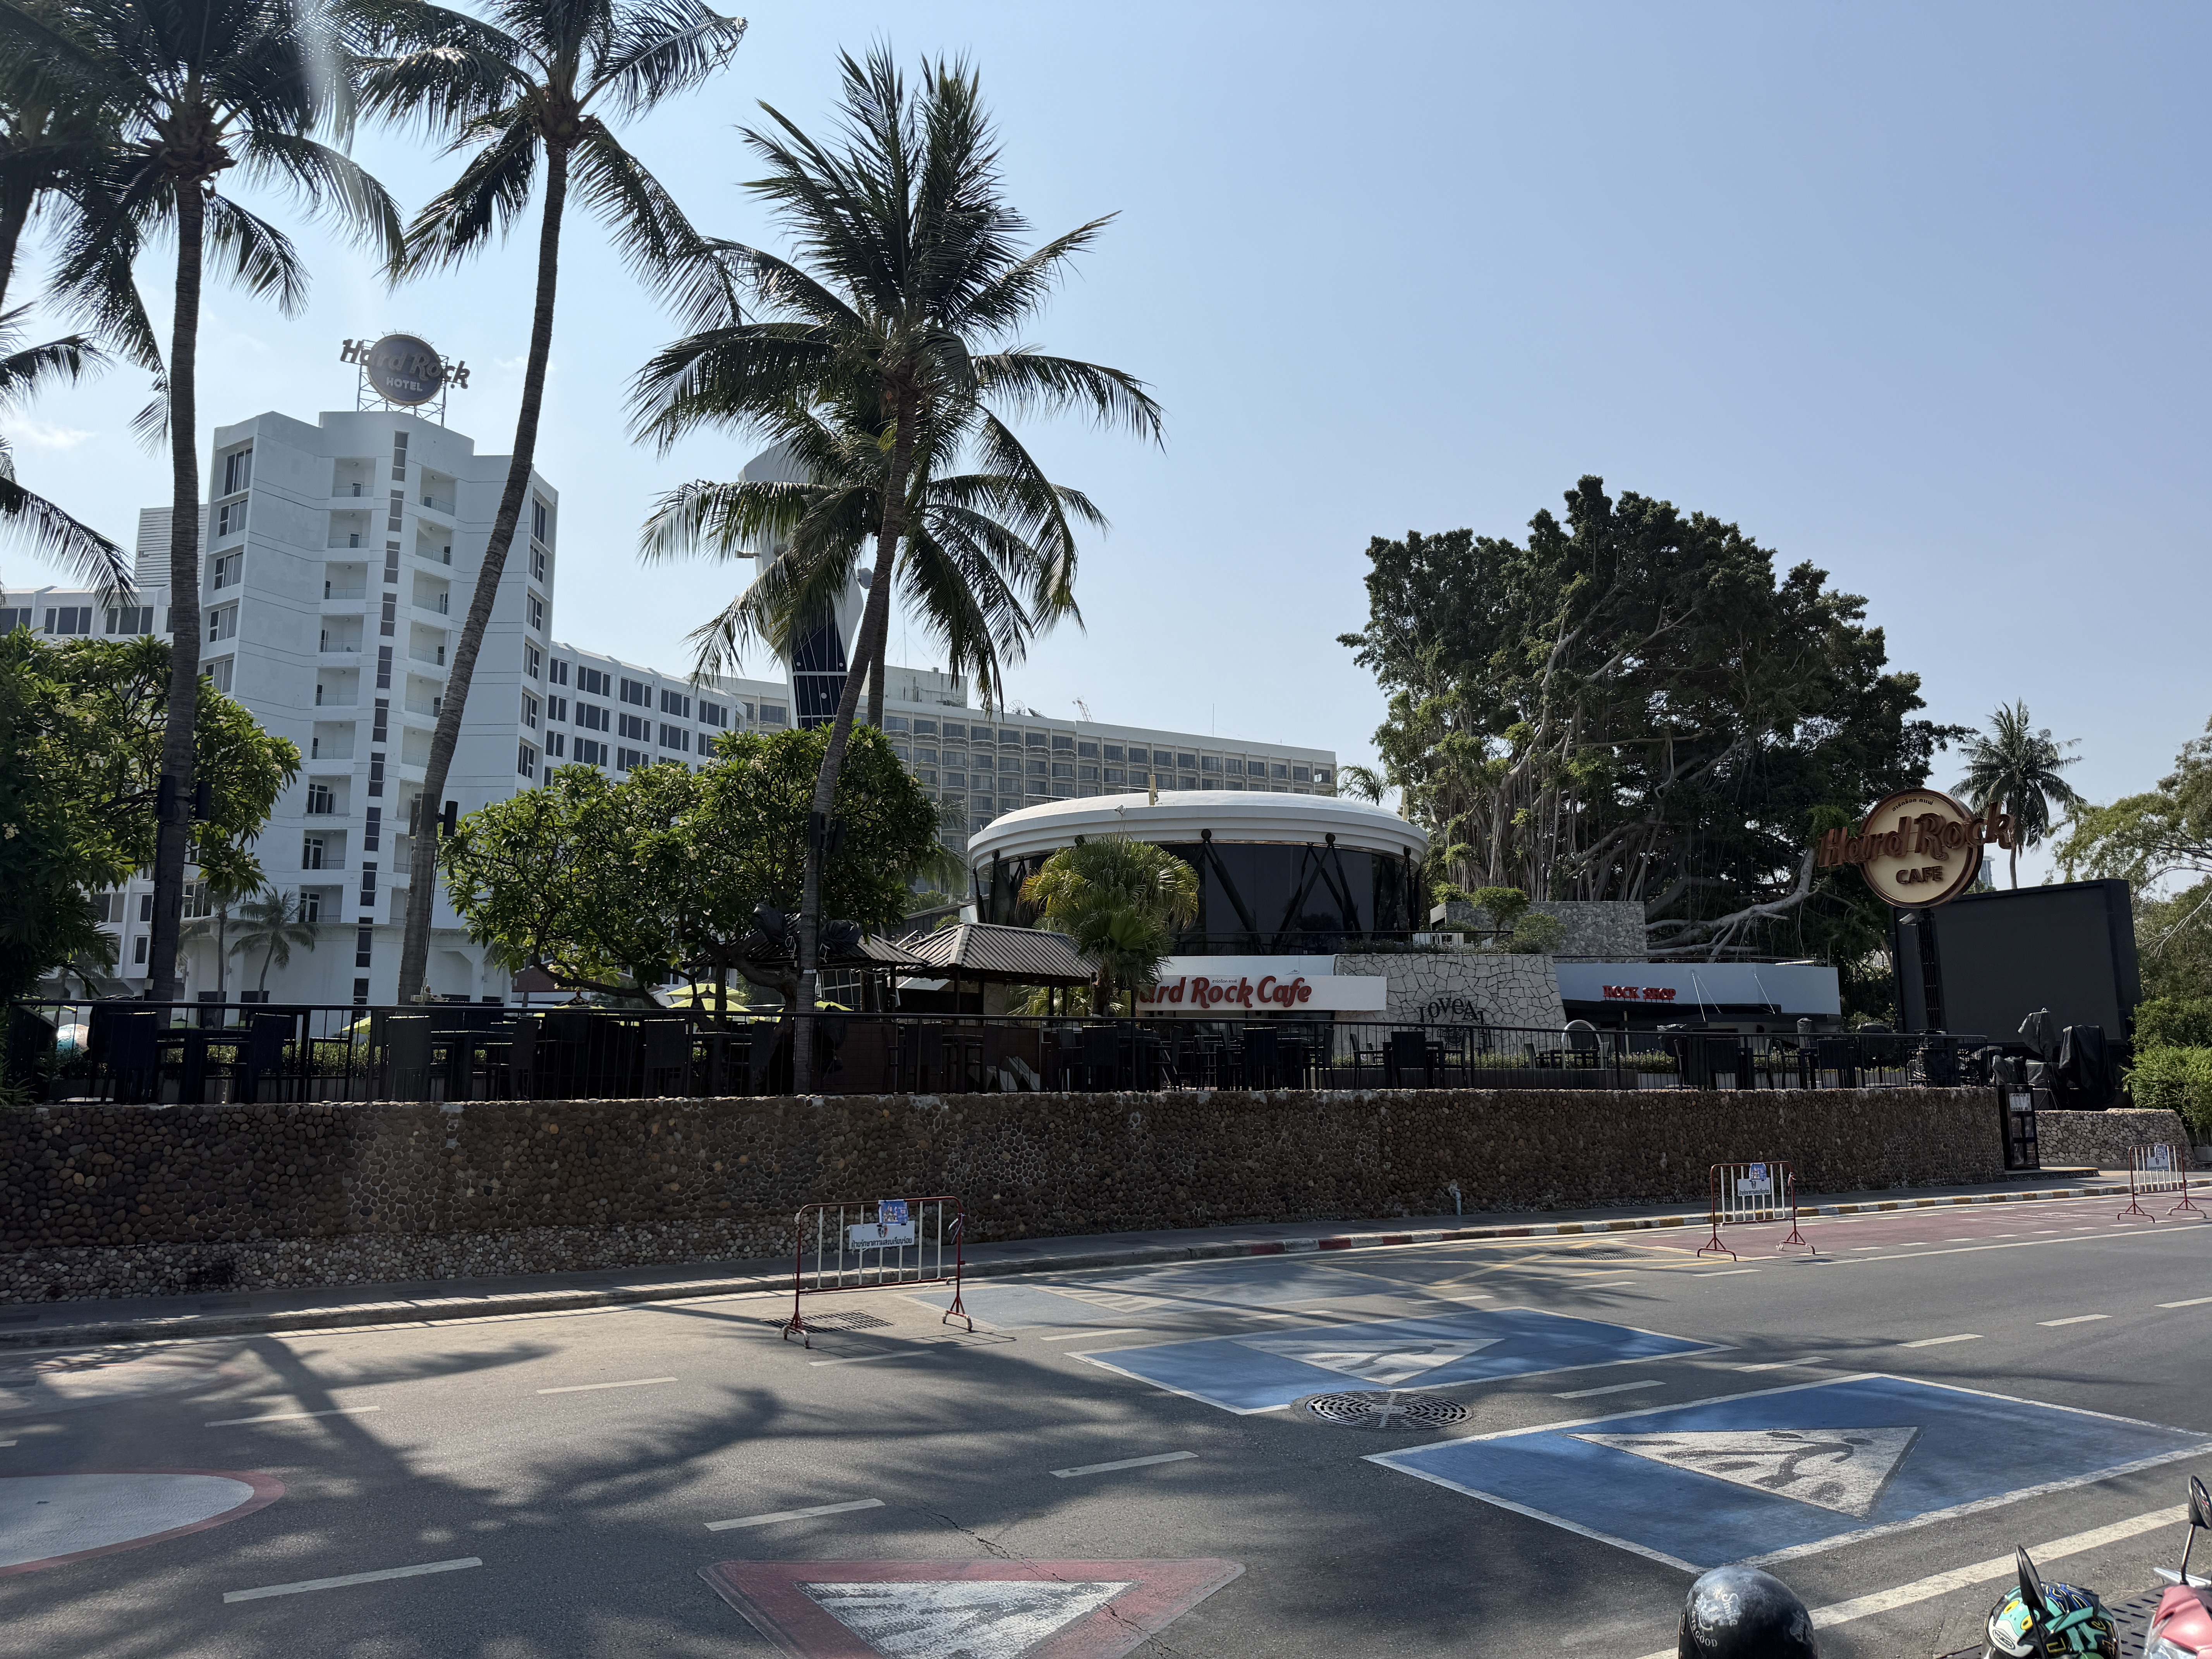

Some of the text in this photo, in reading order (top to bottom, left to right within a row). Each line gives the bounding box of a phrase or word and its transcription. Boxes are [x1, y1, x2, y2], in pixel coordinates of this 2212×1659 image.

[340, 338, 470, 389] Hard Rock
[386, 377, 423, 392] HOTEL
[1818, 802, 2014, 867] Hard Rock
[1896, 865, 1943, 885] CAFE
[1139, 975, 1312, 1008] ard Rock Cafe
[1602, 985, 1676, 1000] ROCK SHOP
[1695, 1630, 1718, 1647] GOOD
